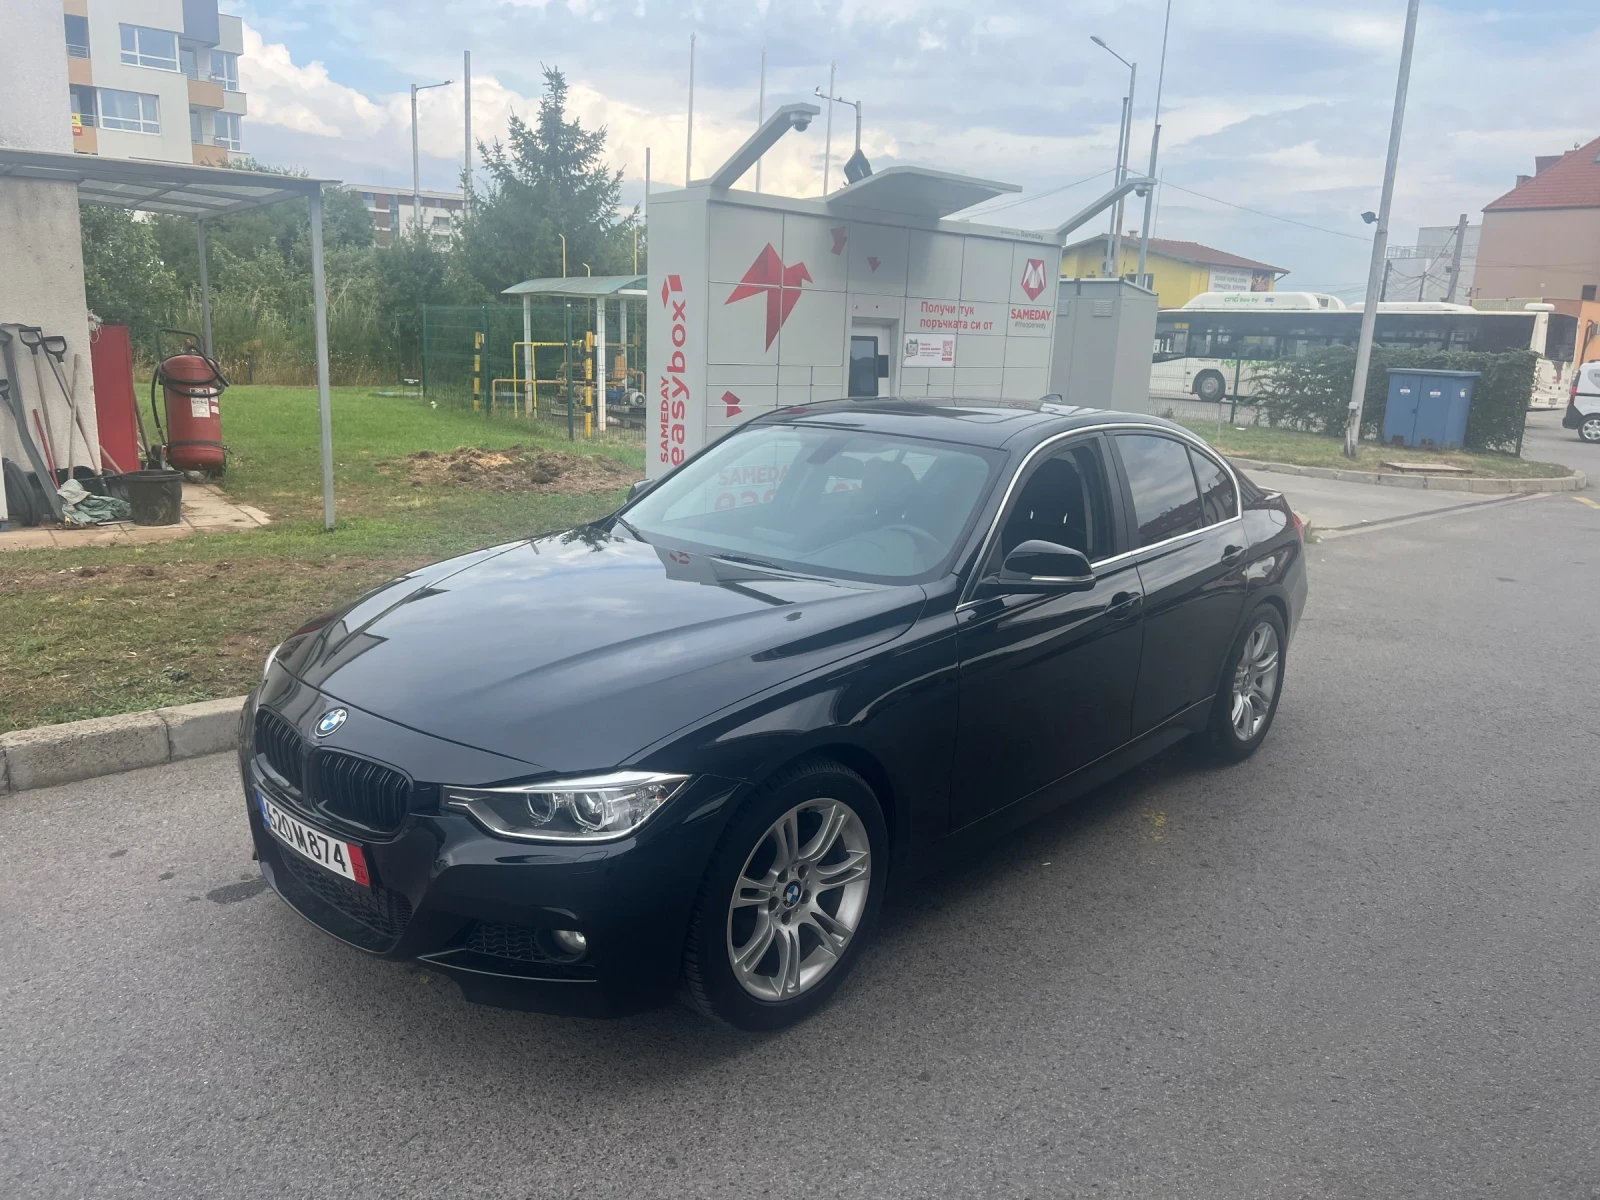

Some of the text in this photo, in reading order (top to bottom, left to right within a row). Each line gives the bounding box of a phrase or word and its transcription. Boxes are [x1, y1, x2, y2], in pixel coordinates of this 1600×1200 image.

[920, 301, 975, 317] Получи тук
[1010, 308, 1052, 321] SAMEDAY
[920, 318, 993, 330] поръчката си от
[667, 299, 690, 466] easybox
[660, 376, 669, 463] SAMEDAY
